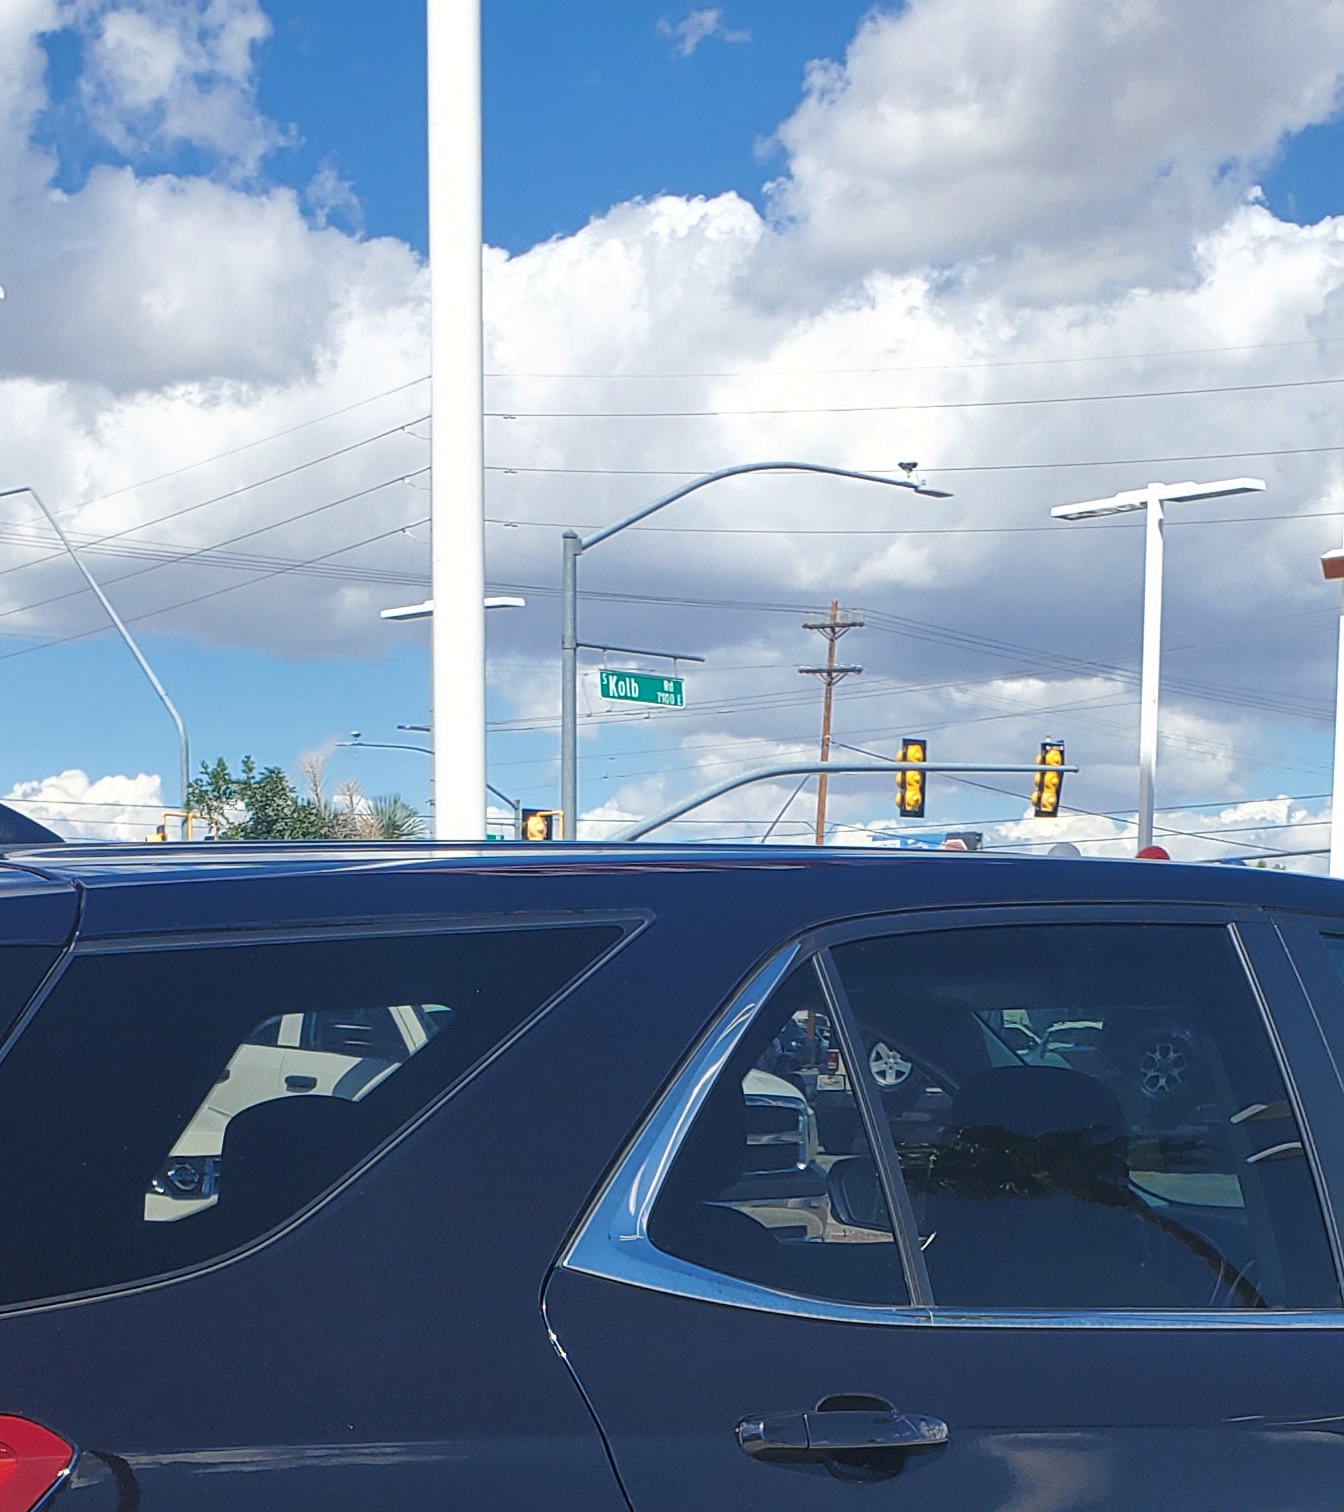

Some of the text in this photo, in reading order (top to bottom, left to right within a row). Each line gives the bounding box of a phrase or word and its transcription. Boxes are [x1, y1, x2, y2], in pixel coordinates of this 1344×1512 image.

[602, 673, 674, 698] S Kolb Rd
